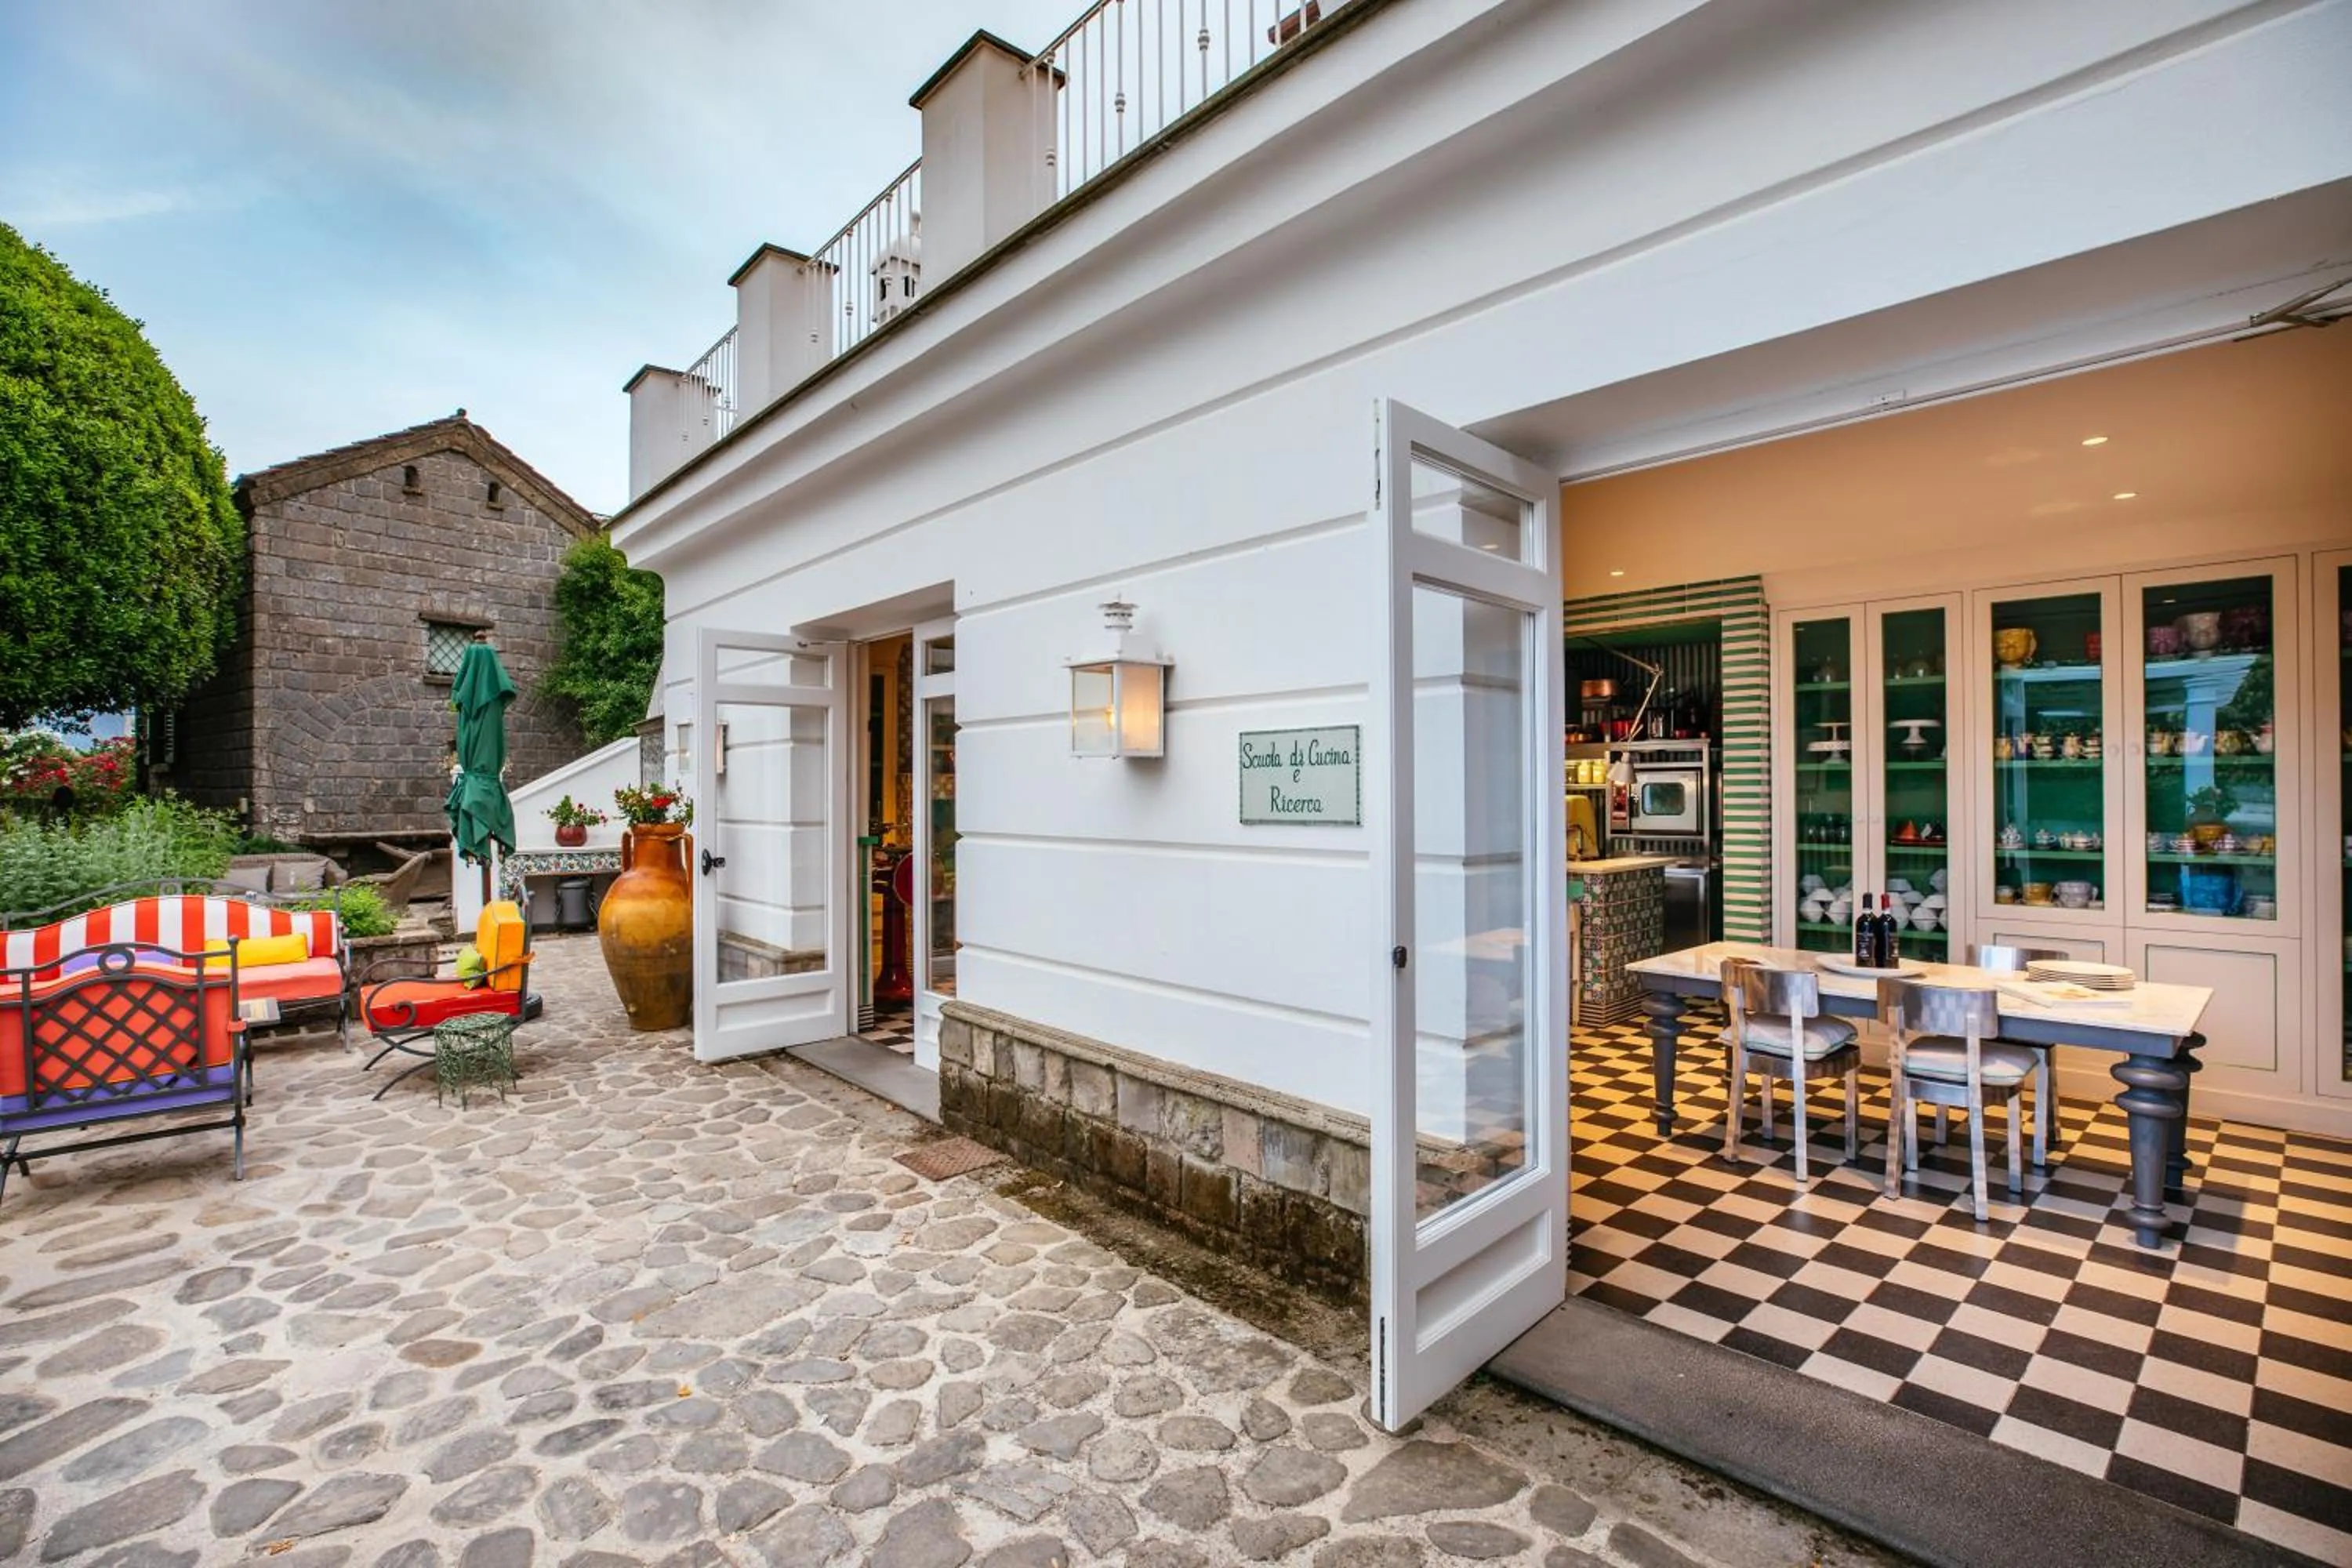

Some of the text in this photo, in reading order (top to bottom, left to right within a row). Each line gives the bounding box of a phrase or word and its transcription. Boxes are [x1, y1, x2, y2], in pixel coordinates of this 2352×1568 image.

[1243, 739, 1352, 769] Scuola di Cucina
[1270, 785, 1323, 813] Ricerca
